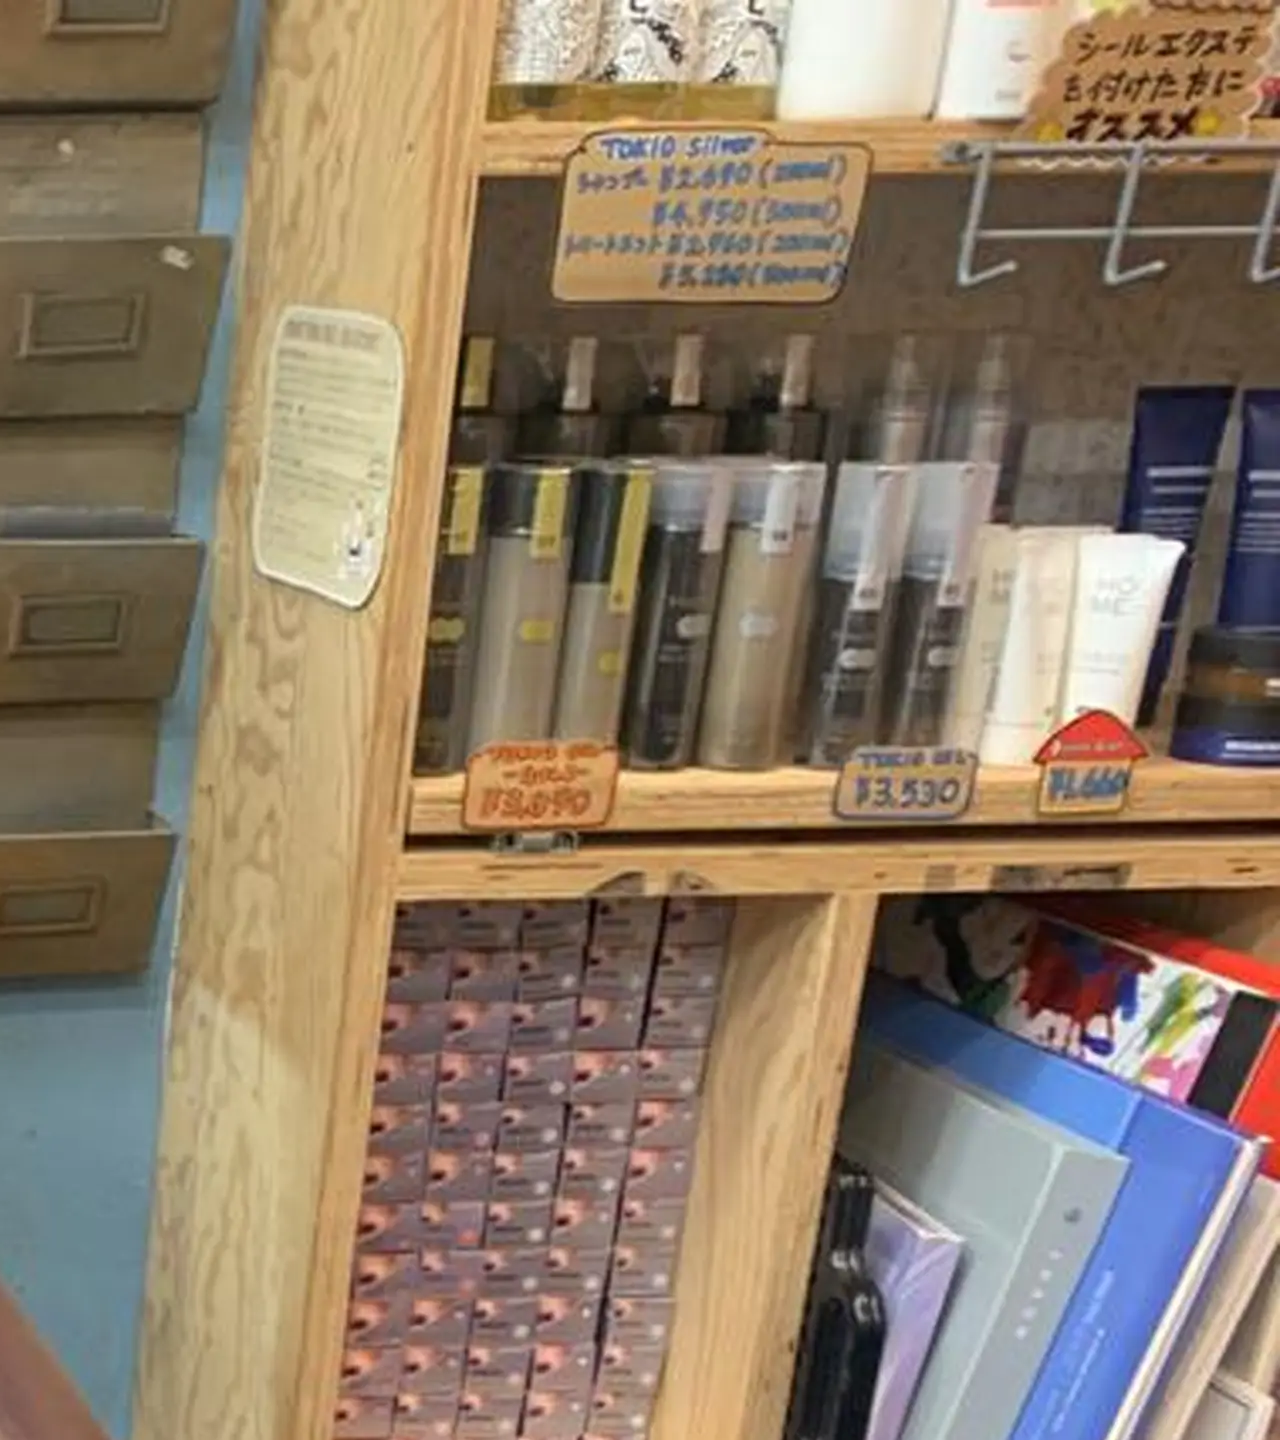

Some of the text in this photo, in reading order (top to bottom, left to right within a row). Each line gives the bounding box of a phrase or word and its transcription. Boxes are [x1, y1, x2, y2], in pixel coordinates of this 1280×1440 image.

[1075, 24, 1257, 66] シールエクステ
[1062, 64, 1245, 103] を付けた方に
[1065, 104, 1198, 142] オススメ
[599, 135, 676, 159] TOKIO
